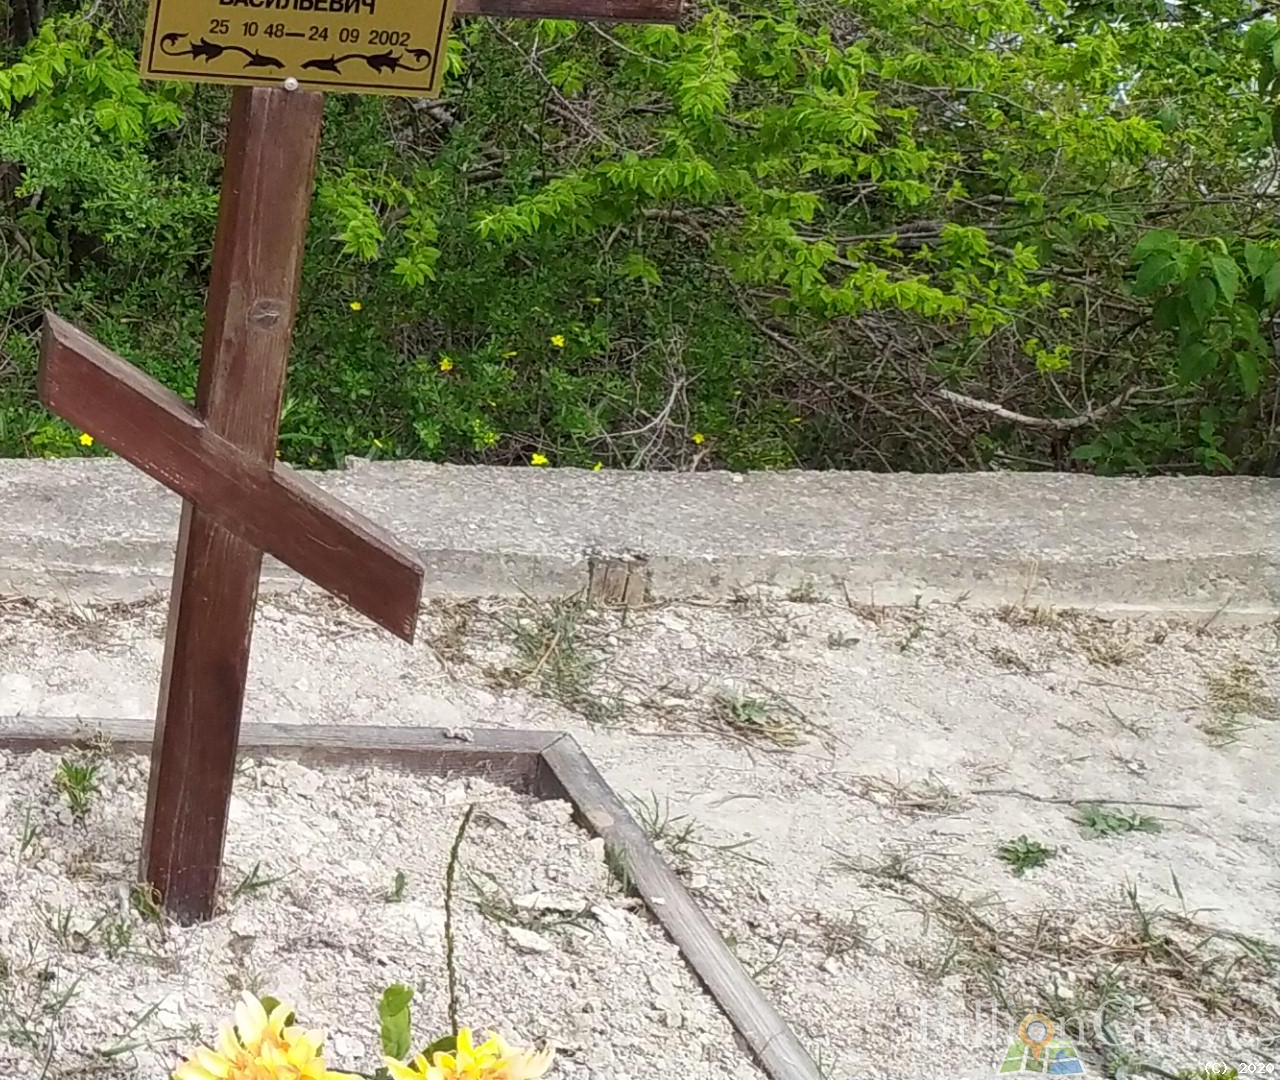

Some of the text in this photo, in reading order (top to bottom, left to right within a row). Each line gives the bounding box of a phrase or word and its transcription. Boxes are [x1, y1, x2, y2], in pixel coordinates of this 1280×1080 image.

[208, 18, 231, 35] 25
[241, 21, 259, 37] 10
[338, 27, 360, 44] 09
[367, 29, 411, 48] 2002
